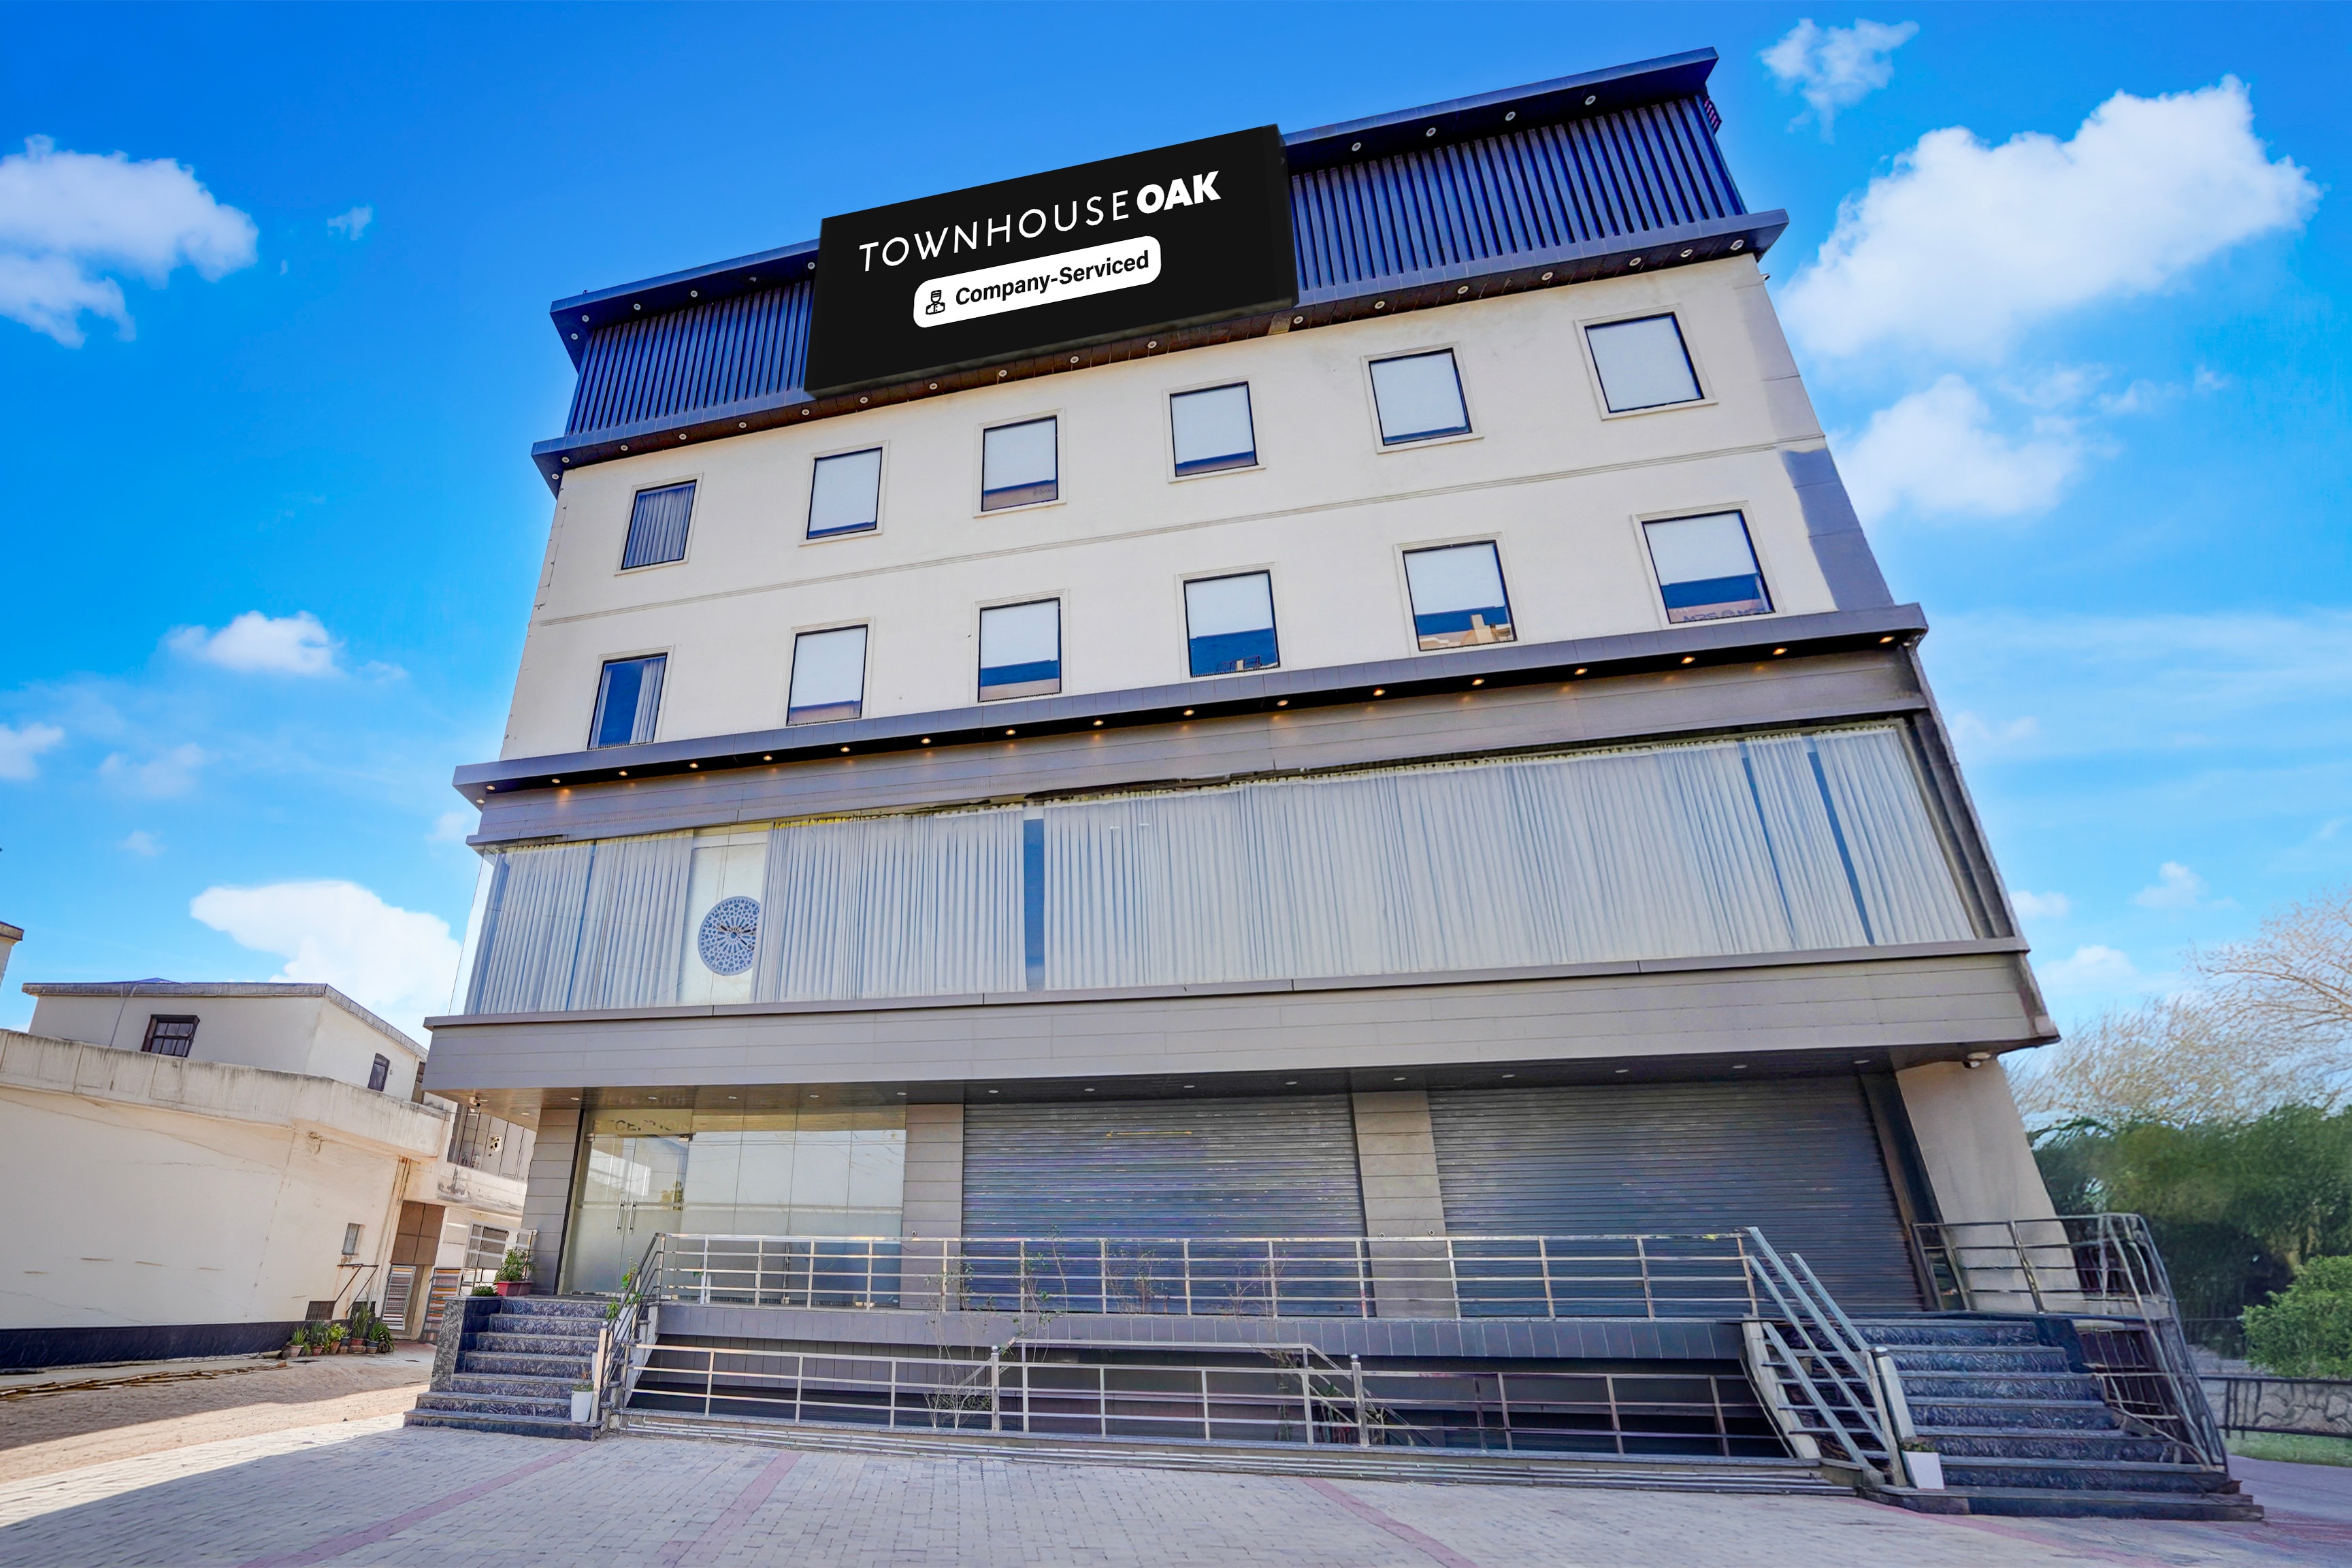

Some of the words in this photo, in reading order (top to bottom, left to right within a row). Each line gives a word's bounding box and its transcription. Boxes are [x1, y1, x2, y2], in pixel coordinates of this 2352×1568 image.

[859, 190, 1129, 272] TOWNHOUSE
[1137, 170, 1222, 214] OAK
[956, 250, 1149, 306] Company-Serviced
